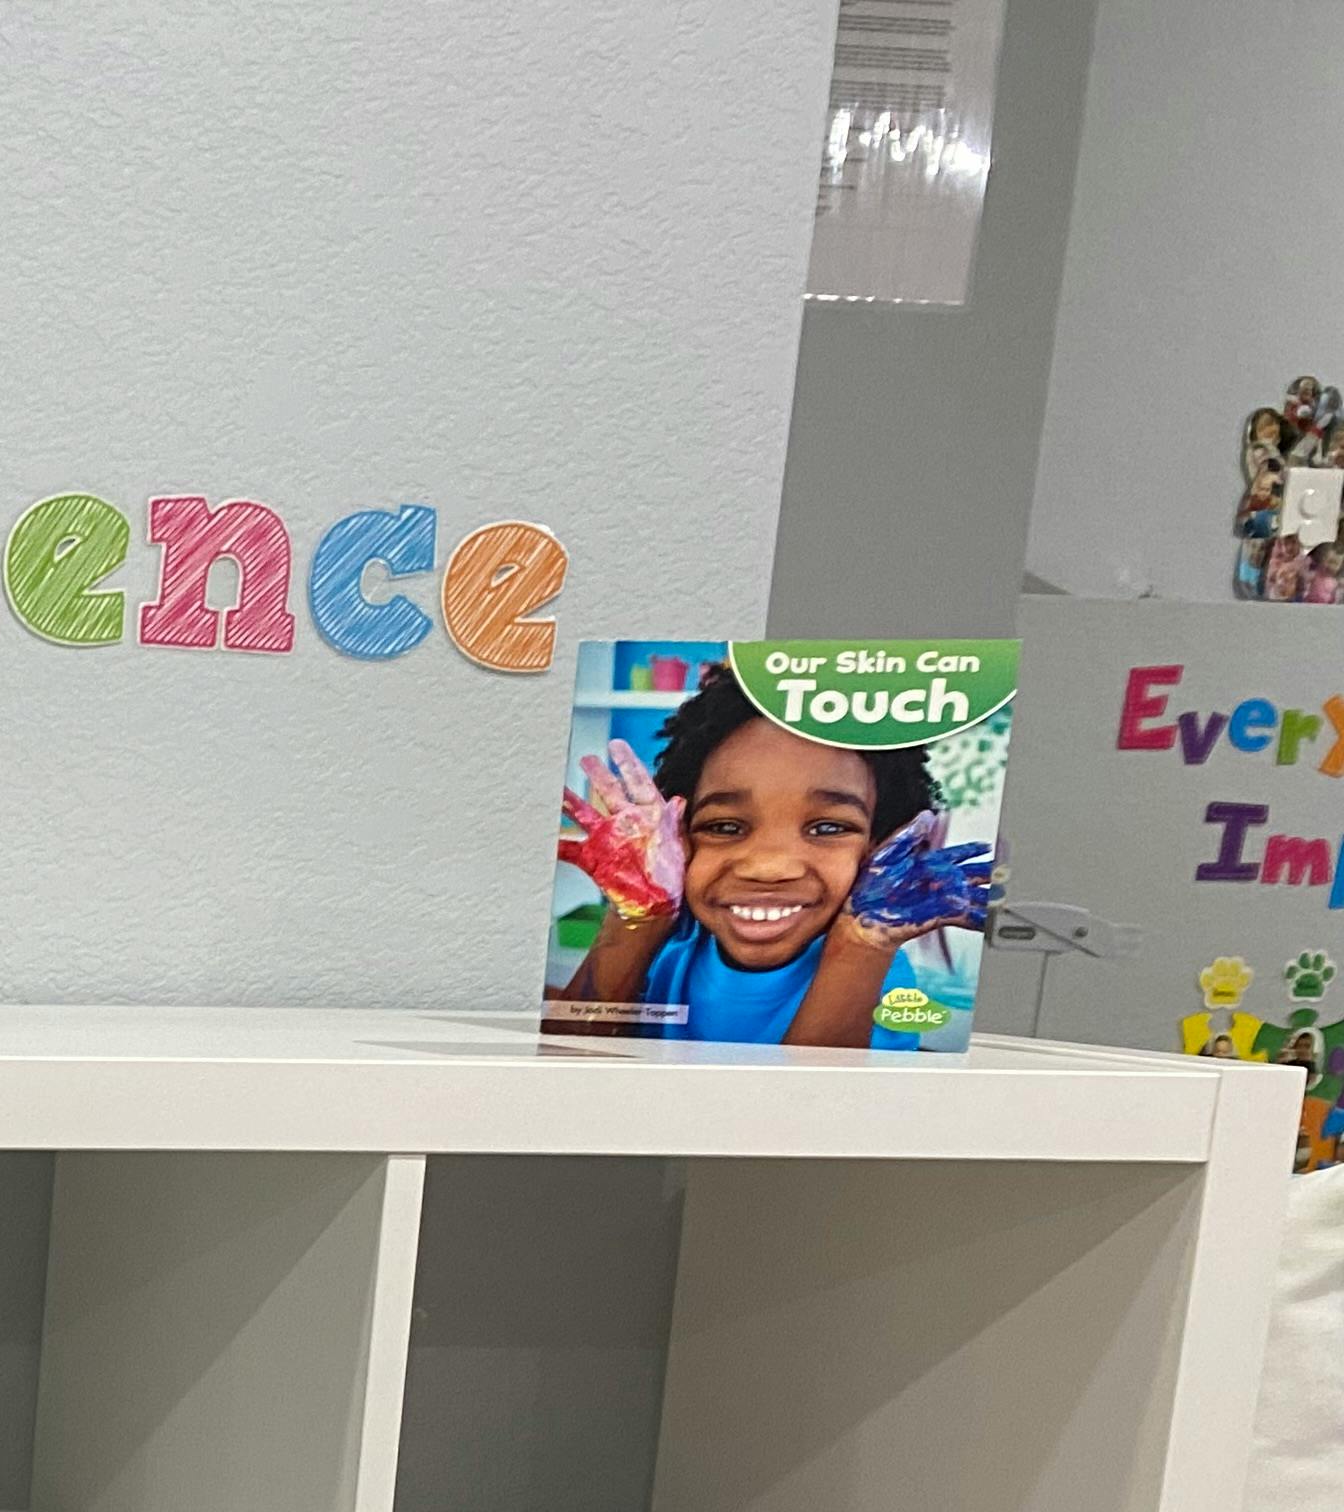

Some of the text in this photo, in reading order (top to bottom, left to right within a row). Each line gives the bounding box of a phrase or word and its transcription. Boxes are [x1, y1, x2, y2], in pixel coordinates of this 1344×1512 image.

[765, 650, 980, 674] Our Skin Can
[776, 678, 970, 724] Touch
[888, 992, 924, 1004] Little
[881, 1007, 943, 1025] Pebble
